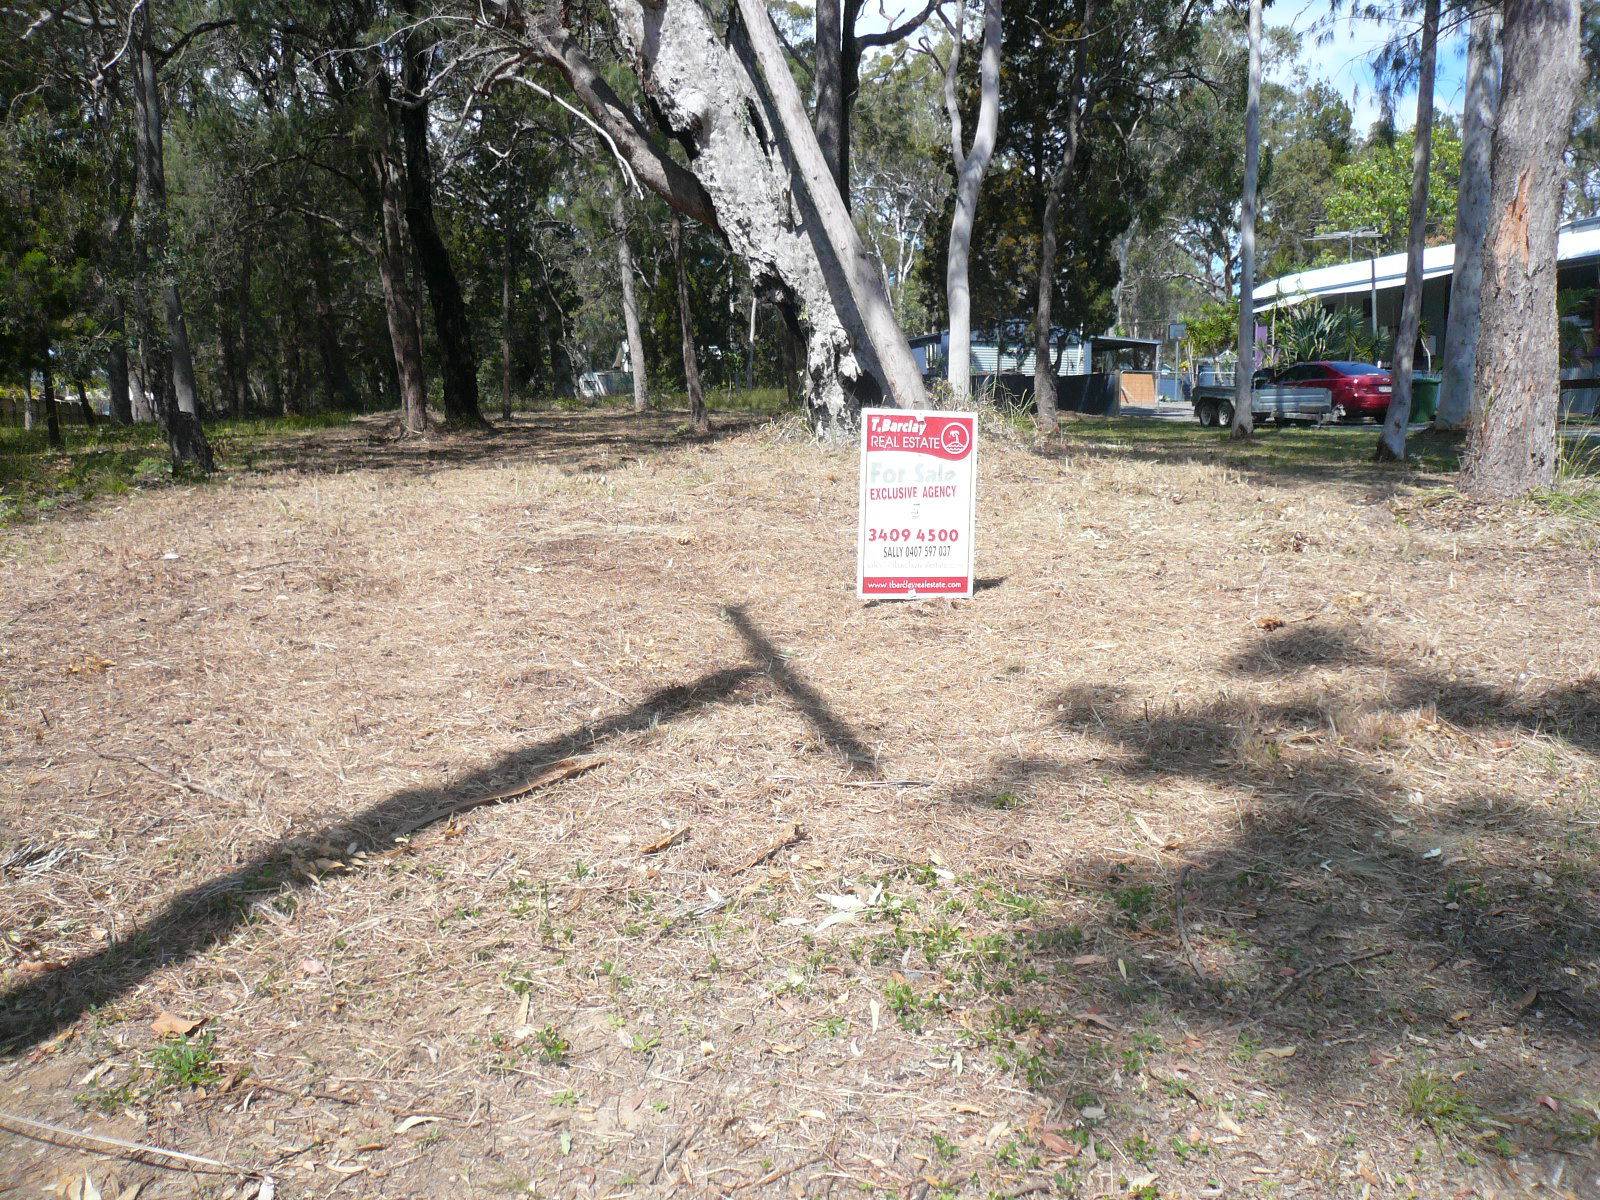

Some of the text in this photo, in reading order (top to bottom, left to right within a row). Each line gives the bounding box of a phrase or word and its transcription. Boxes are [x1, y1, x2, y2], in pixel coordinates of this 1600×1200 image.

[871, 418, 927, 436] T.Barclay
[871, 435, 940, 449] REAL ESTATE
[871, 462, 956, 483] For Sale
[870, 485, 957, 501] EXCLUSIVE AGENCY
[868, 528, 959, 542] 3409 4500
[883, 545, 951, 558] SALLY 0407 597 037
